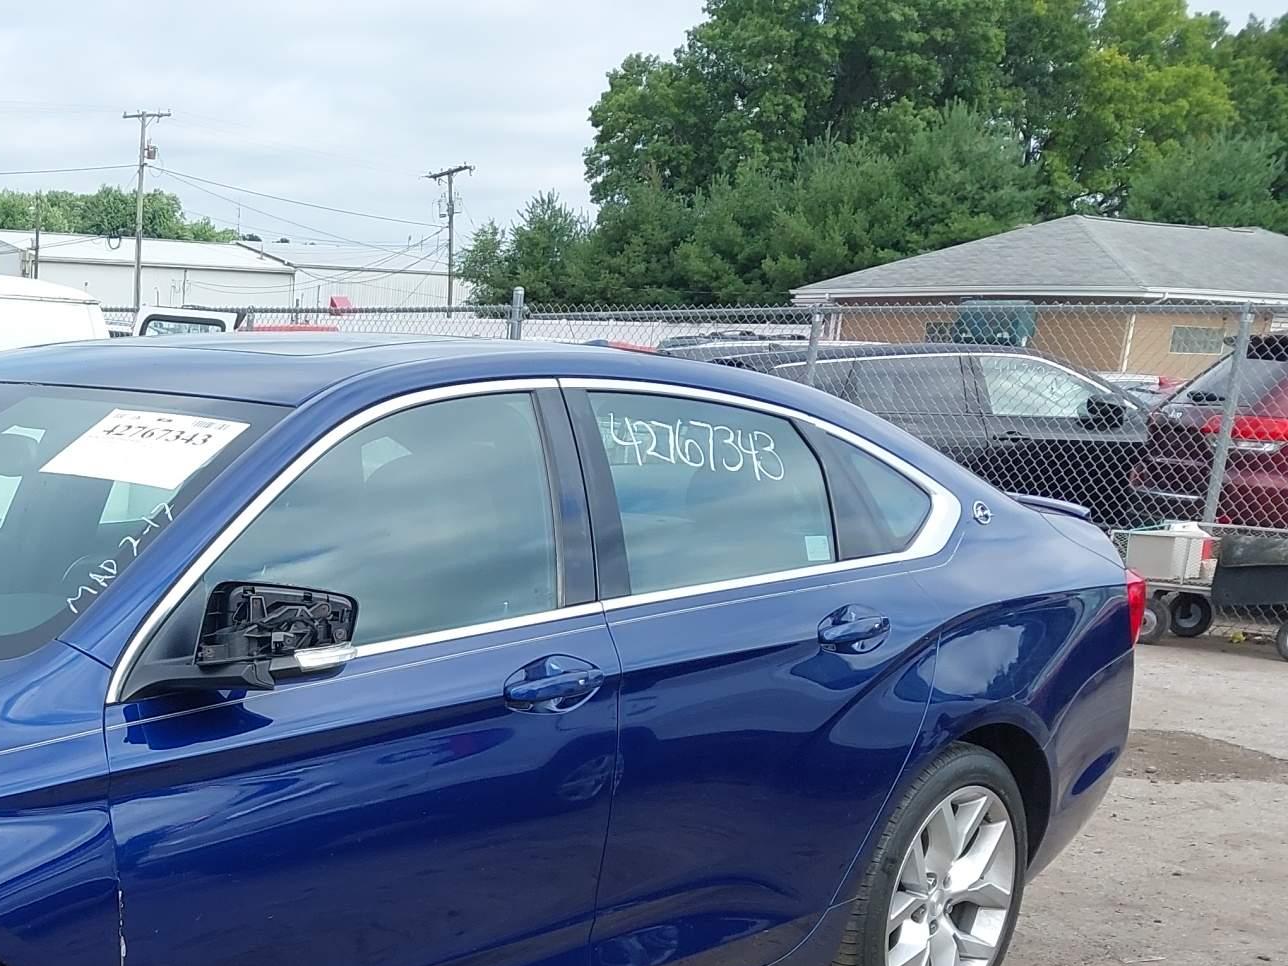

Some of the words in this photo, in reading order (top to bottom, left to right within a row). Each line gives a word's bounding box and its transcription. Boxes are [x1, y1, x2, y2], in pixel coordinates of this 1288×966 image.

[103, 423, 213, 447] 42767343
[608, 412, 785, 481] 42767343
[66, 559, 118, 614] MAD
